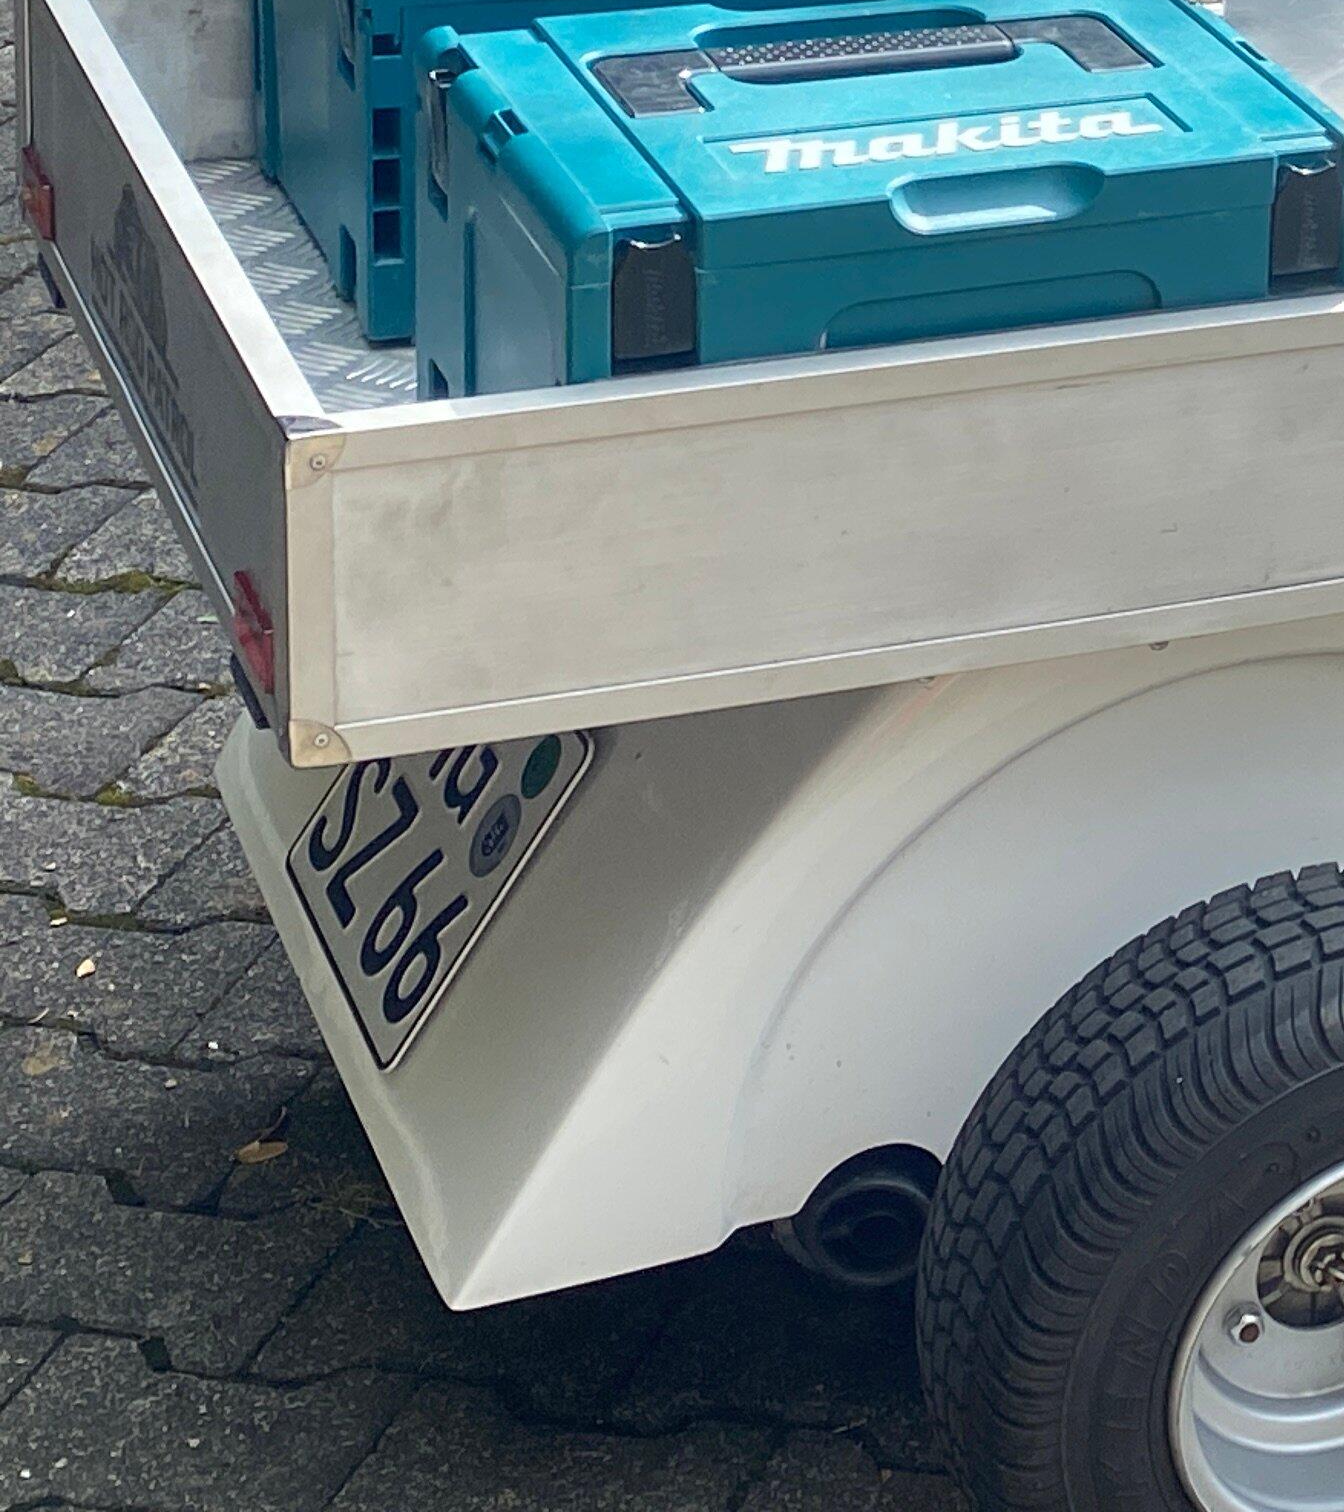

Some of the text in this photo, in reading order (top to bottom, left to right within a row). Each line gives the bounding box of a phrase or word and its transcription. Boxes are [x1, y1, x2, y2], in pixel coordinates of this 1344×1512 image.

[728, 110, 1164, 174] makita
[308, 756, 469, 1023] SZ 66
